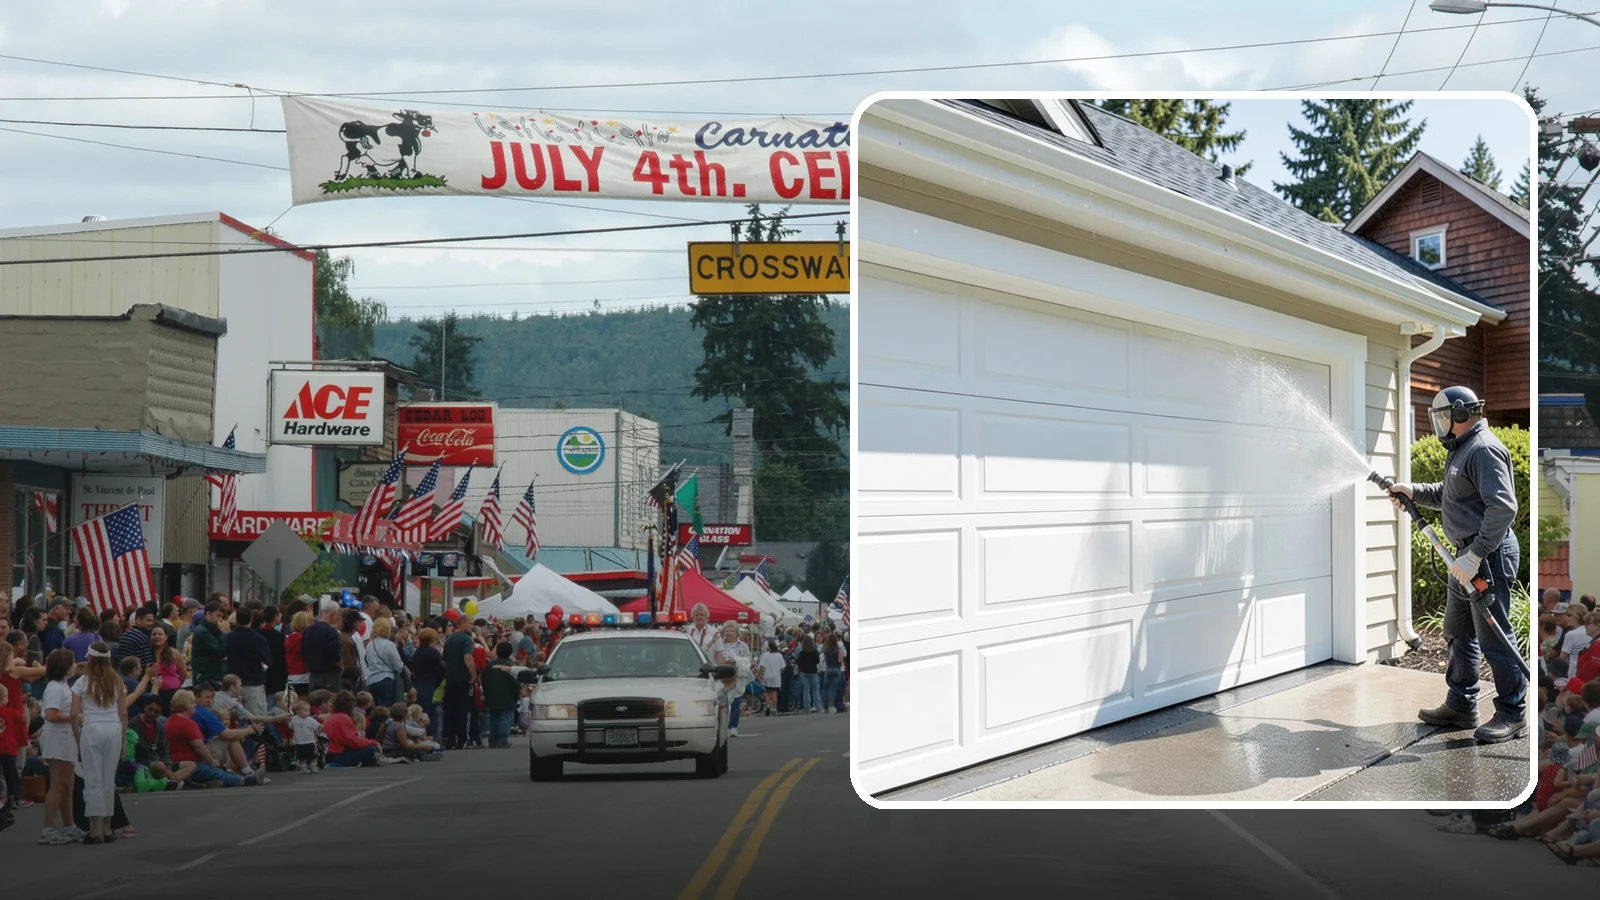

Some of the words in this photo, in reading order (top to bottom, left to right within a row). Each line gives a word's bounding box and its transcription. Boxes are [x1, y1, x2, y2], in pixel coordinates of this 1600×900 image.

[481, 141, 605, 193] JULY
[632, 150, 747, 198] 4th.
[697, 254, 850, 280] CROSSWA
[283, 380, 374, 420] ACE
[405, 409, 452, 423] CEDAR
[460, 409, 485, 422] LOG
[283, 421, 371, 436] Hardware
[416, 428, 477, 447] Coca-Cola
[95, 484, 124, 495] Vincent
[126, 485, 136, 495] de
[137, 485, 155, 495] Paul
[688, 526, 742, 535] CRNATION
[699, 535, 730, 543] GLASS
